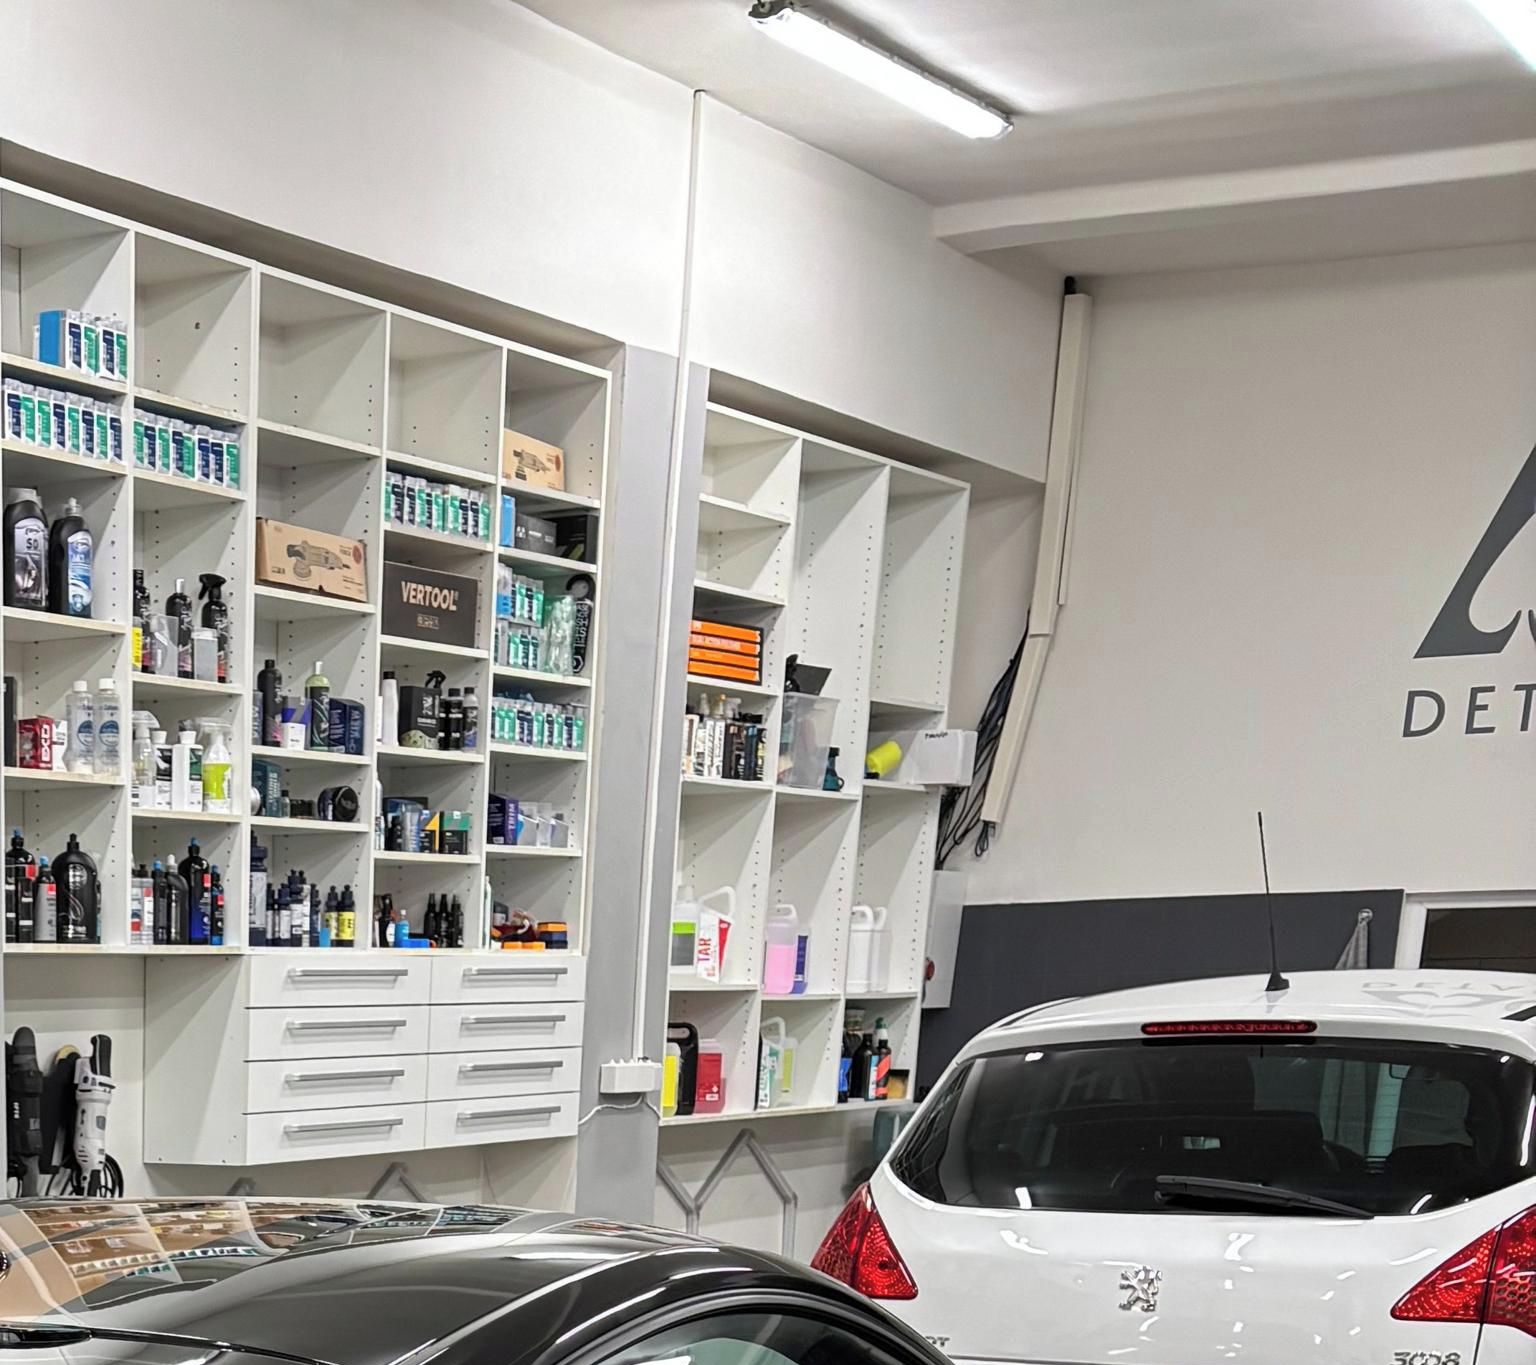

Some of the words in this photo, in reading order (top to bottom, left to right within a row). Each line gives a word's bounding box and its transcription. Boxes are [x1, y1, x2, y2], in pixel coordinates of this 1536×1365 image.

[400, 580, 457, 611] VERTOOL
[1401, 682, 1536, 738] DET
[696, 937, 712, 962] TAR
